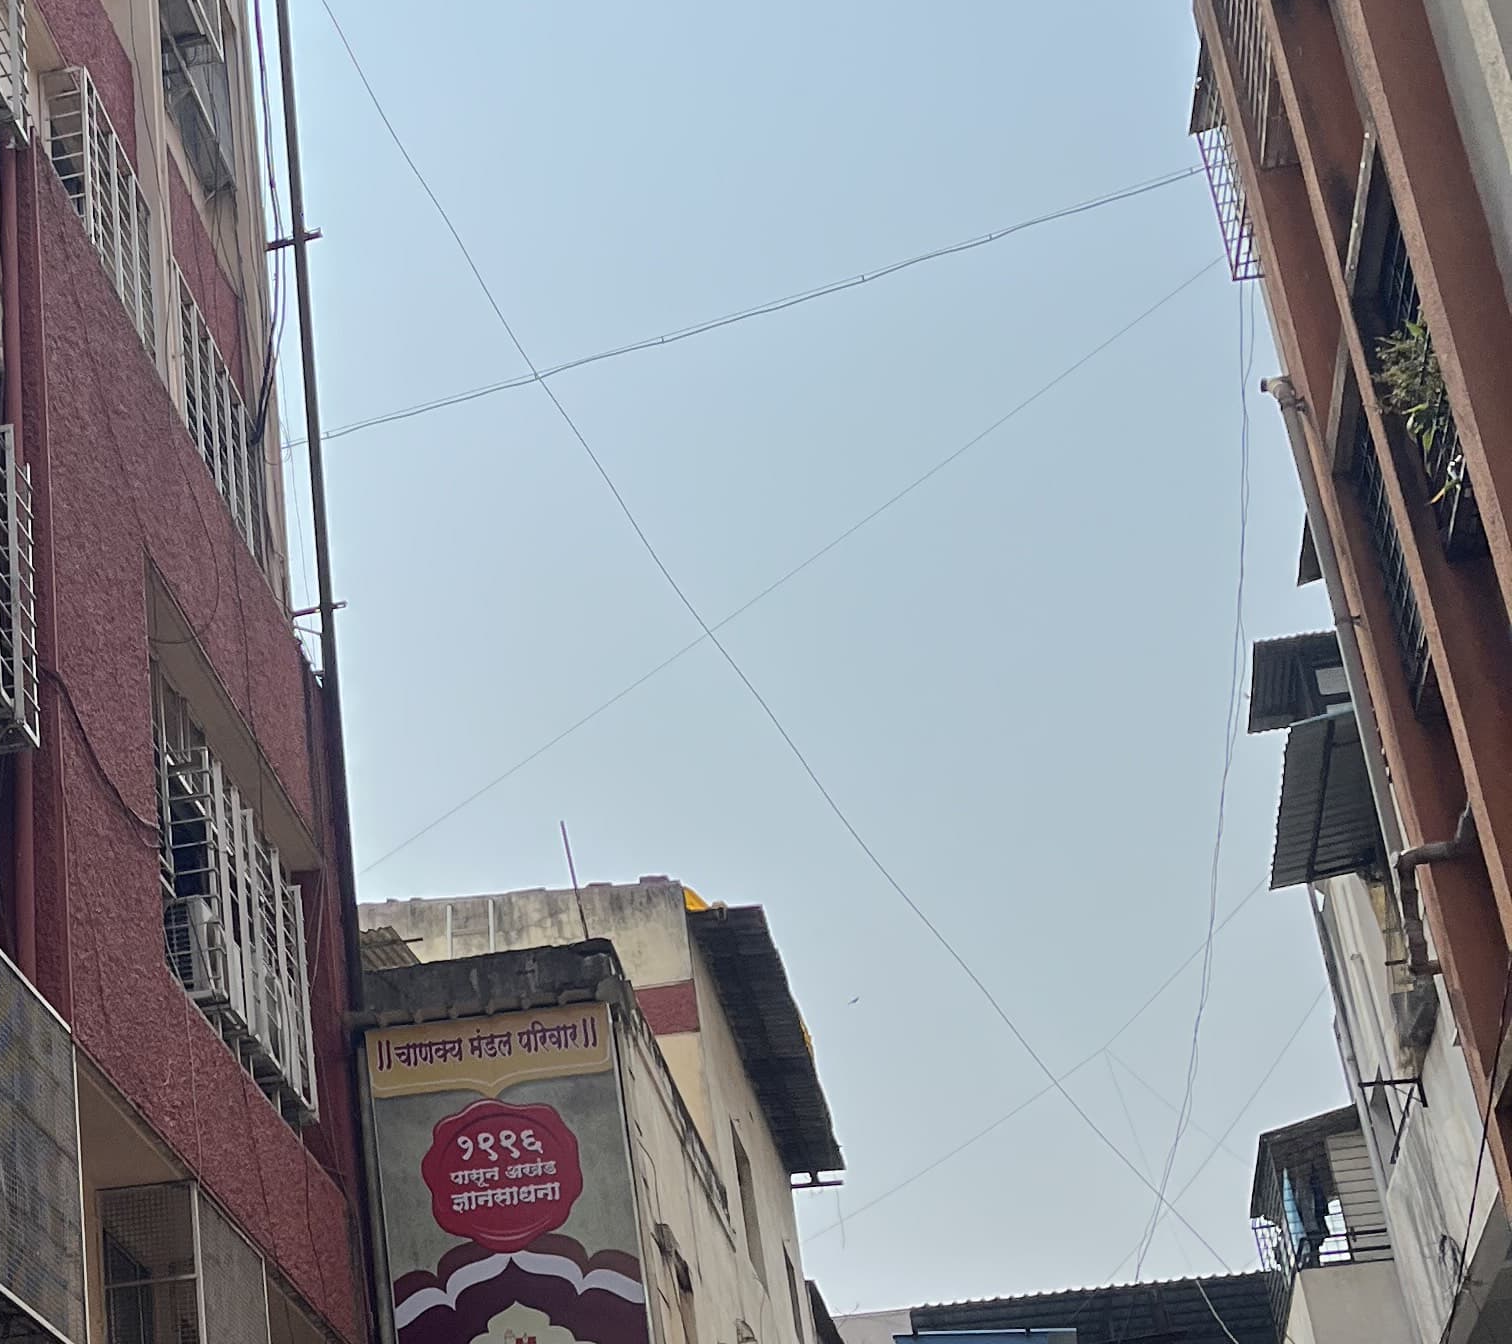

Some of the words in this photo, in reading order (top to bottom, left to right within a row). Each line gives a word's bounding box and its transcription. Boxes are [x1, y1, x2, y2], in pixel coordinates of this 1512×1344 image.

[468, 1028, 512, 1059] मंडल
[457, 1129, 543, 1161] १९९६
[450, 1166, 499, 1188] पासून
[505, 1157, 557, 1179] अखंड
[451, 1182, 561, 1214] ज्ञानसाधना
